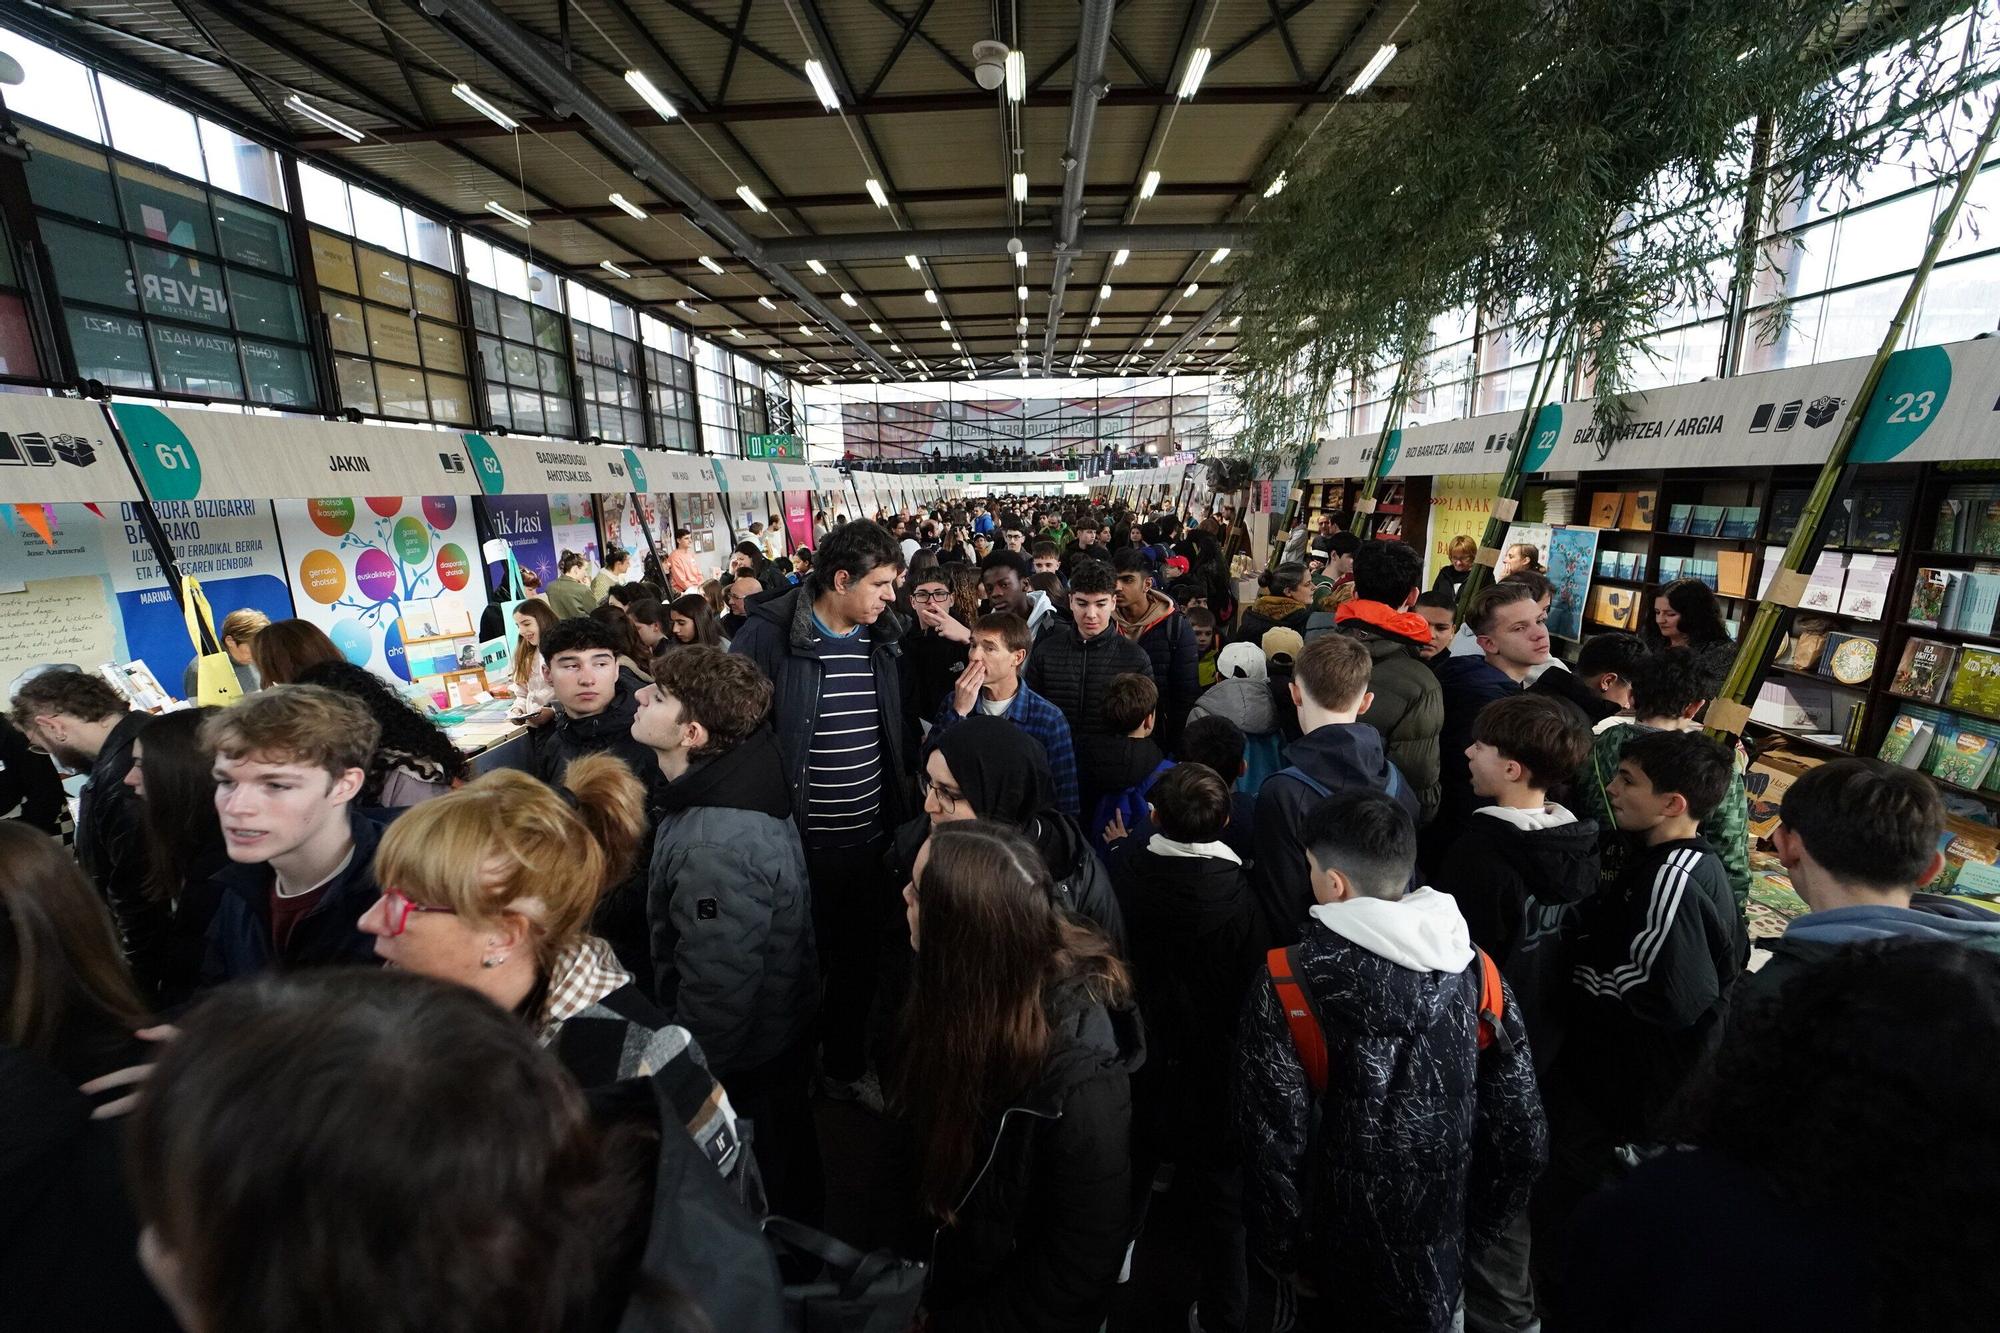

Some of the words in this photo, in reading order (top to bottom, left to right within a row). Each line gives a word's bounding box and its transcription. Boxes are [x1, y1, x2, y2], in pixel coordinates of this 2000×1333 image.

[1887, 391, 1935, 424] 23
[1573, 426, 1594, 444] BIZI
[1674, 415, 1724, 436] ARGIA
[752, 437, 763, 456] 01
[1538, 430, 1556, 449] 22
[154, 442, 191, 471] 61
[1387, 449, 1397, 461] 21
[1405, 447, 1416, 458] BIZI
[1417, 445, 1447, 457] BARATZEA
[1454, 441, 1475, 454] ARGIA
[329, 455, 371, 472] JAKIN
[483, 457, 500, 474] 62
[546, 469, 593, 482] AHOTSAK.EUS
[1447, 474, 1489, 489] GURE
[195, 499, 255, 518] BIZIGARRI
[1448, 498, 1490, 513] LANAK
[515, 510, 542, 533] hasi
[1442, 518, 1484, 537] ZURE
[188, 541, 232, 557] ERRADIKAL
[235, 540, 263, 553] BERRIA
[136, 566, 153, 580] ETA
[216, 556, 253, 570] DENBORA
[308, 568, 337, 578] gerrako
[311, 577, 338, 588] ahotsak
[140, 590, 172, 604] MARINA
